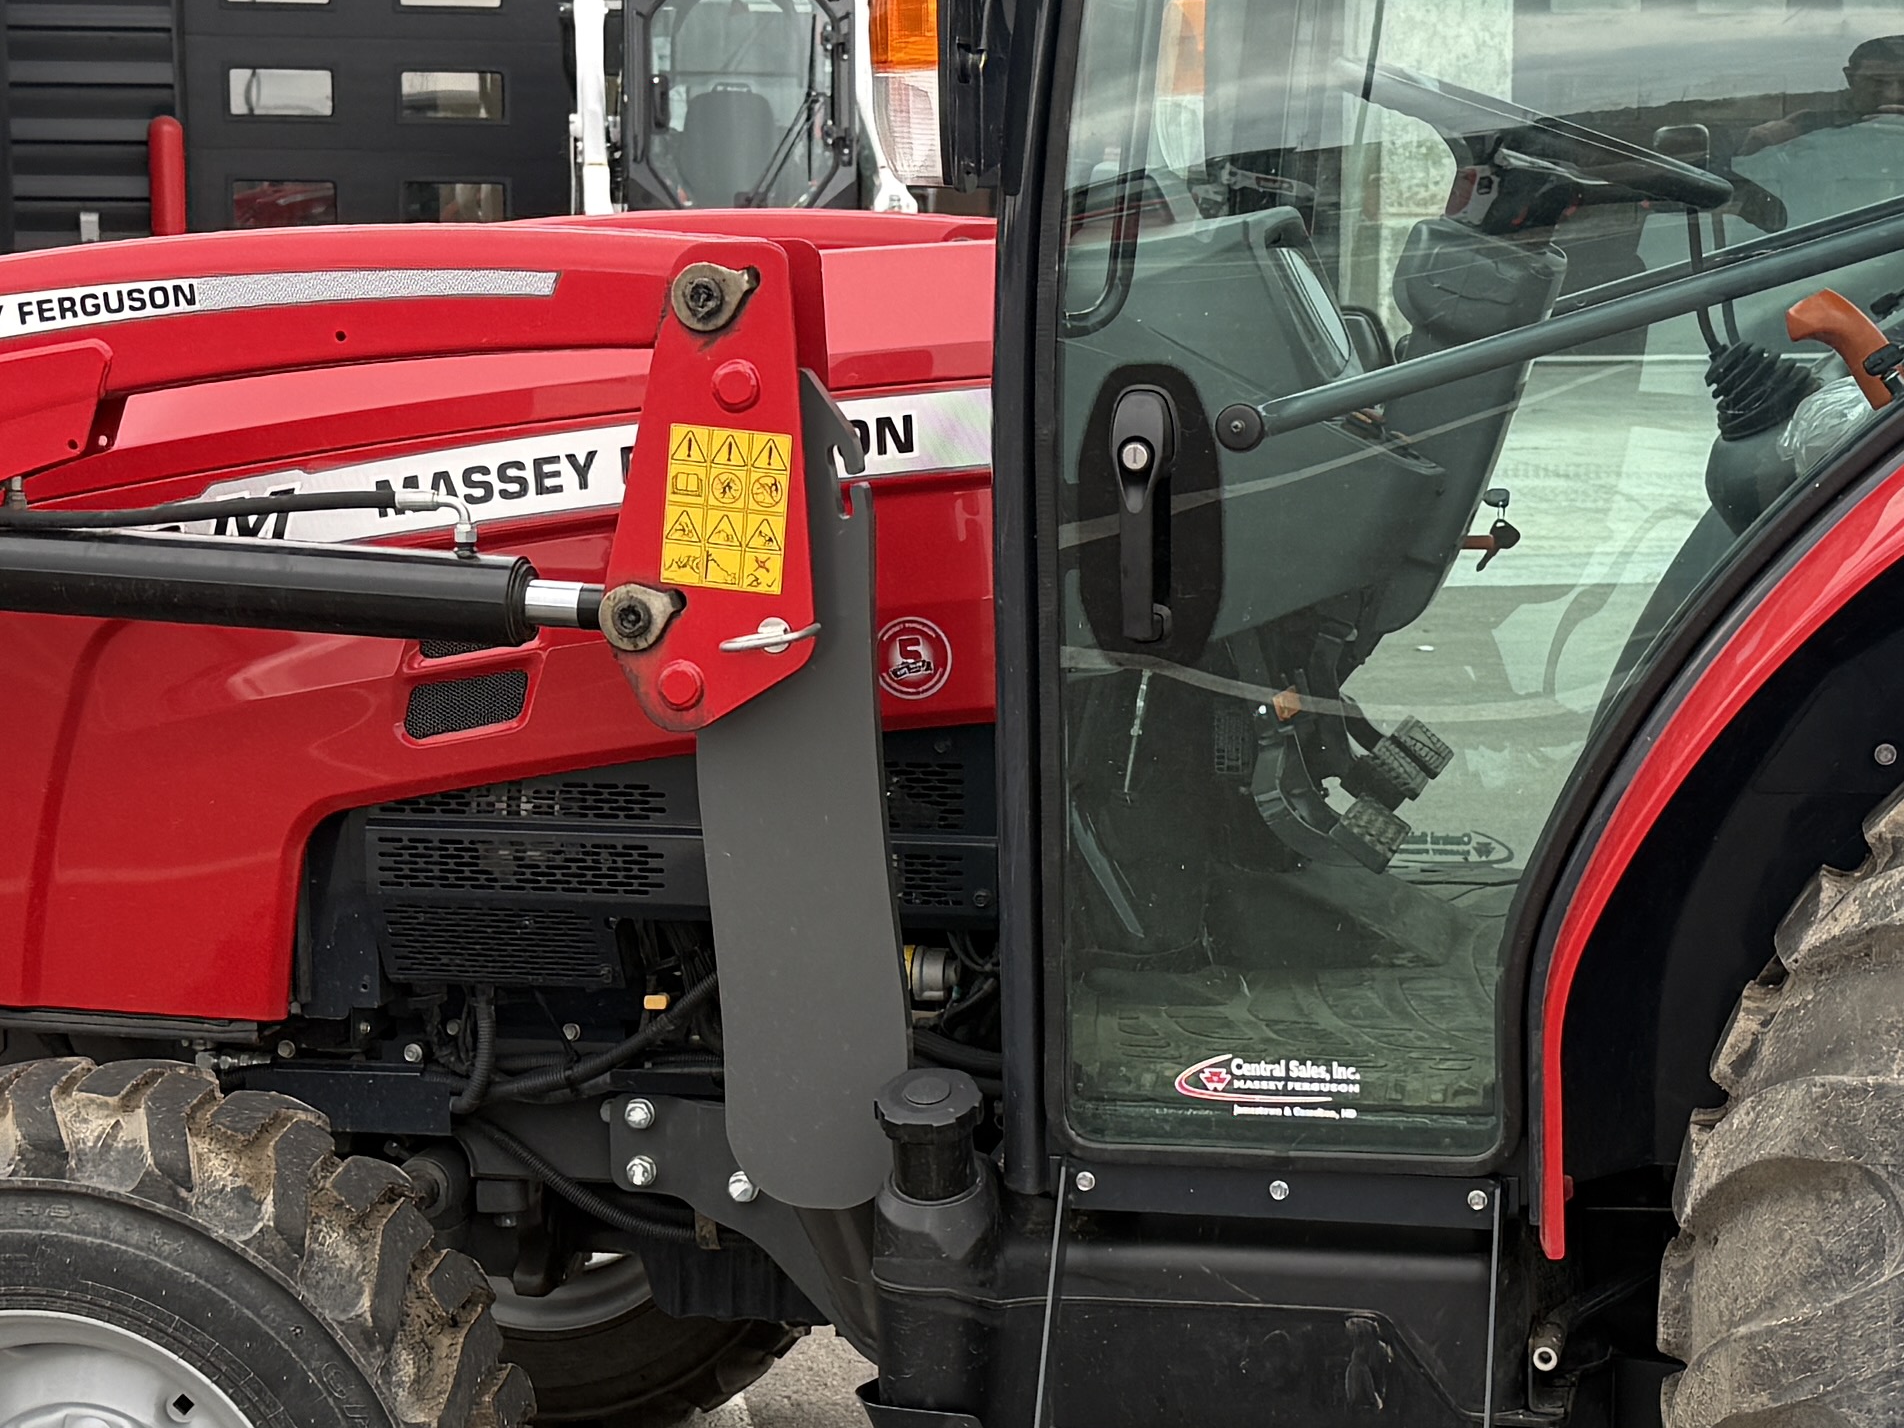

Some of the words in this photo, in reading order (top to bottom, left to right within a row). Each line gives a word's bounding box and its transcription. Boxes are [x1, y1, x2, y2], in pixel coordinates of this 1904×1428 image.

[18, 283, 197, 326] FERGUSON
[1230, 1058, 1286, 1077] Central
[1288, 1059, 1331, 1081] Sales,
[1332, 1062, 1361, 1080] Inc.
[1233, 1080, 1285, 1091] MASSEY
[1287, 1081, 1360, 1093] FERGUSON
